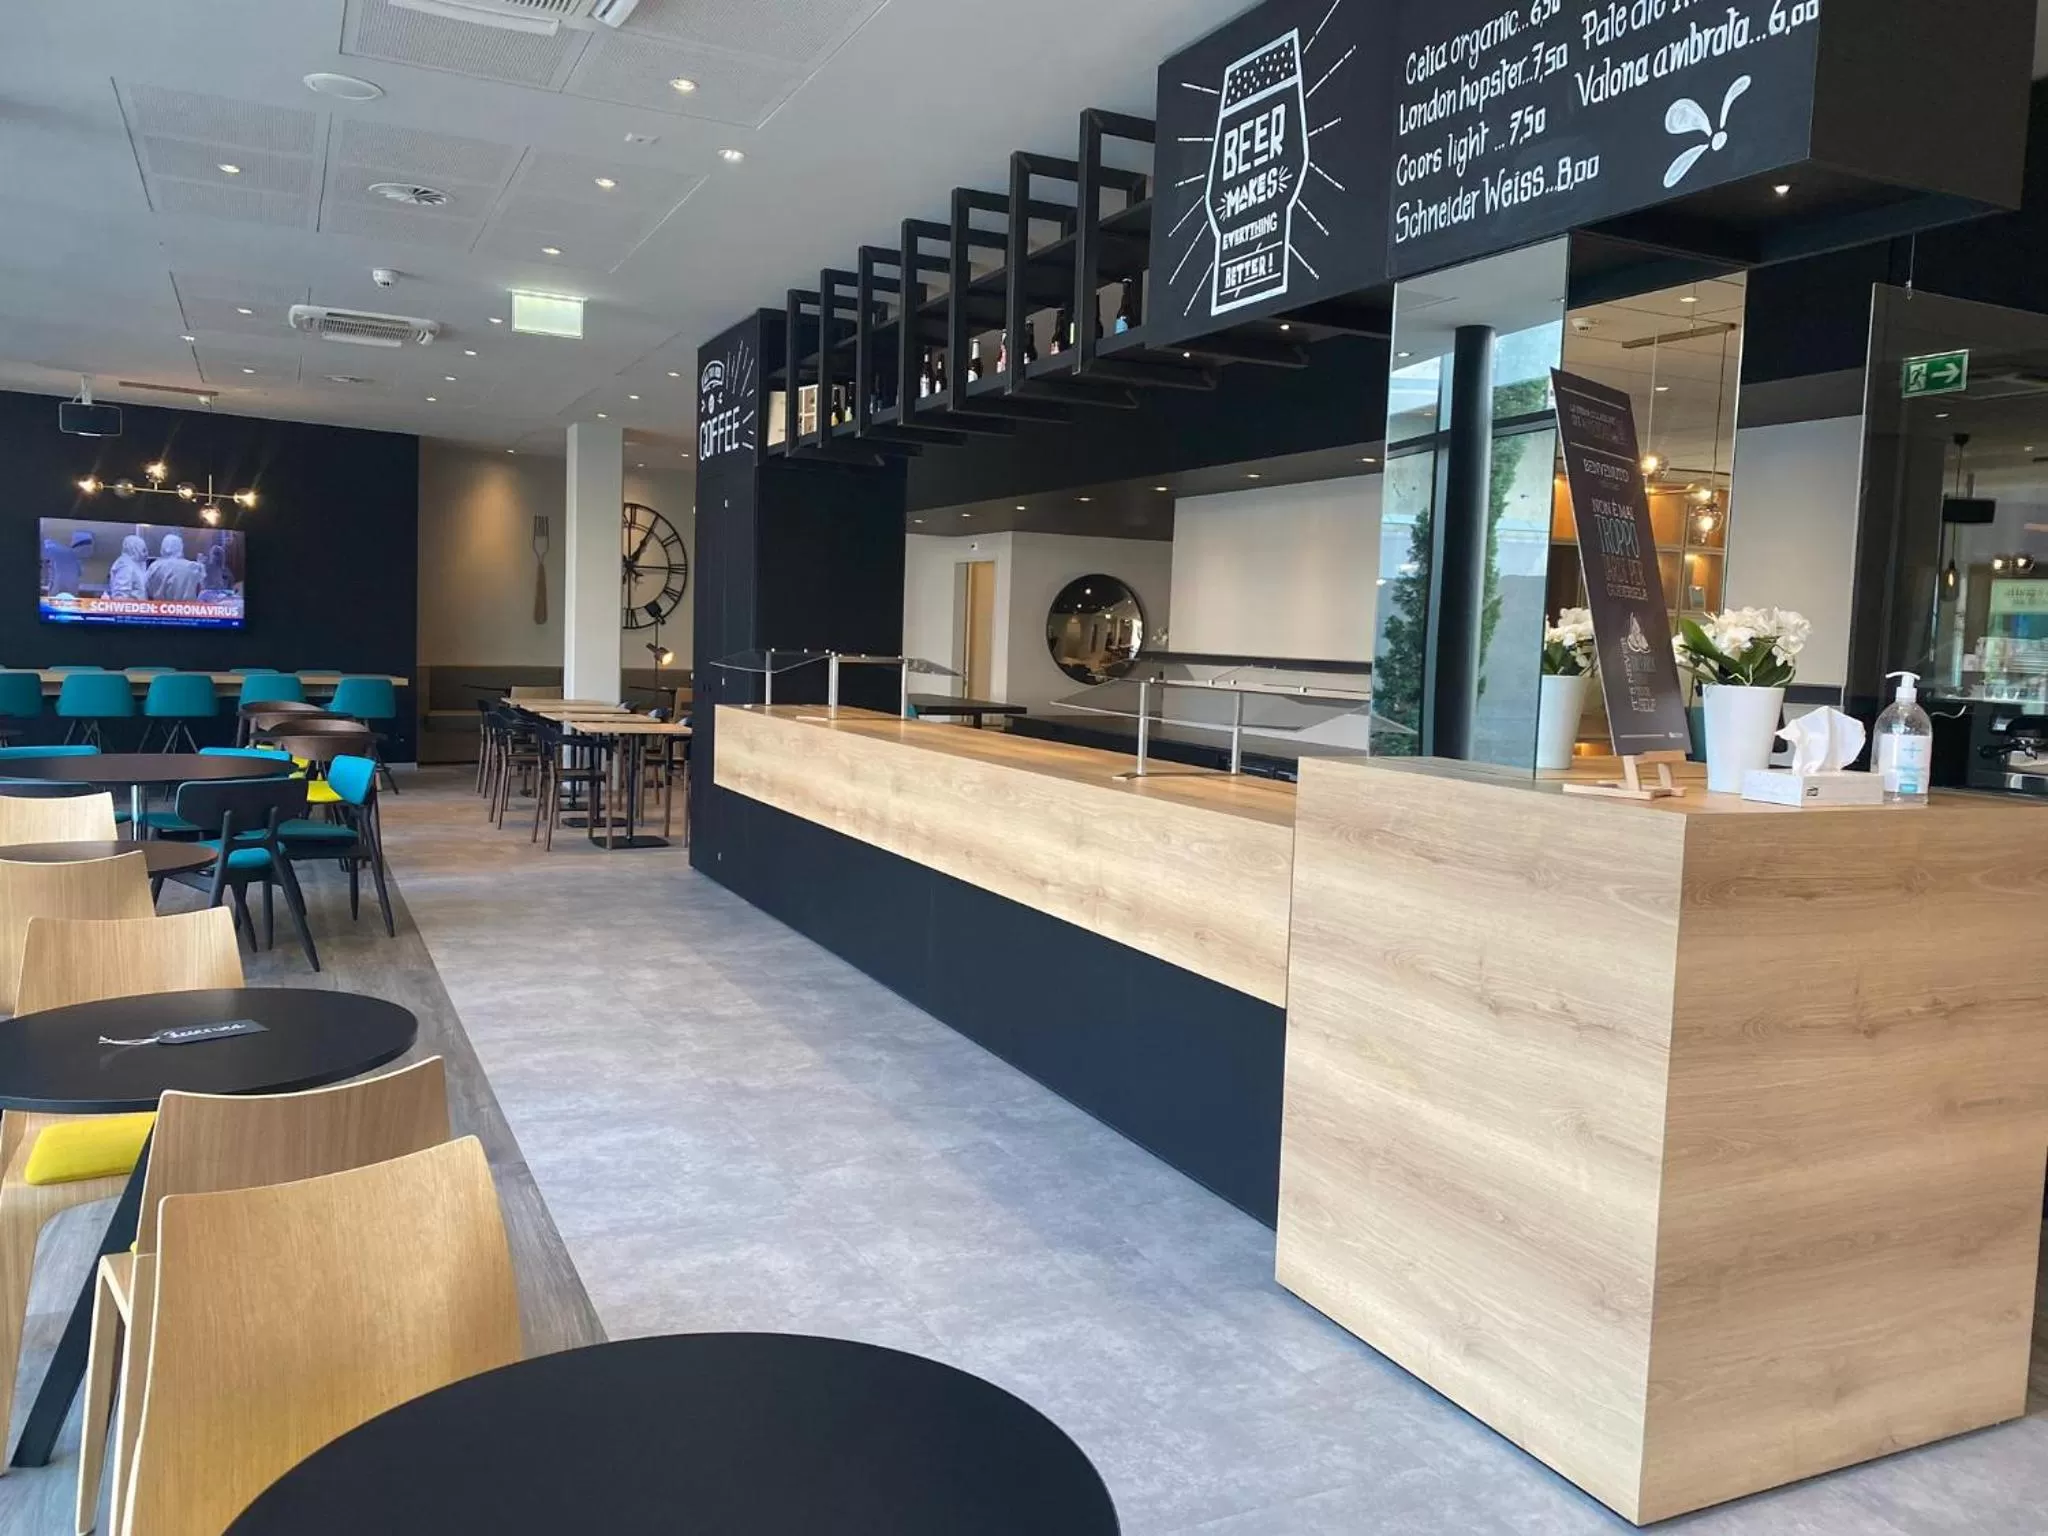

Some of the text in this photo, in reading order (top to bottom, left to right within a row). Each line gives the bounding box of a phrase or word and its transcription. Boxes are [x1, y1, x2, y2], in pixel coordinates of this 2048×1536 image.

[1581, 2, 1627, 50] Pale
[1406, 42, 1448, 85] Celia
[1574, 53, 1649, 106] Valona
[1400, 87, 1456, 136] London
[1223, 103, 1286, 181] BEER
[1396, 148, 1442, 186] Coors
[1448, 121, 1489, 177] light
[1225, 167, 1278, 217] MAKES
[1396, 186, 1480, 244] Schneider
[1222, 211, 1277, 250] EVERYTHING
[700, 406, 740, 461] COFFEE
[90, 601, 158, 615] SCHWEDEN:
[159, 603, 239, 617] CORONAVIRUS
